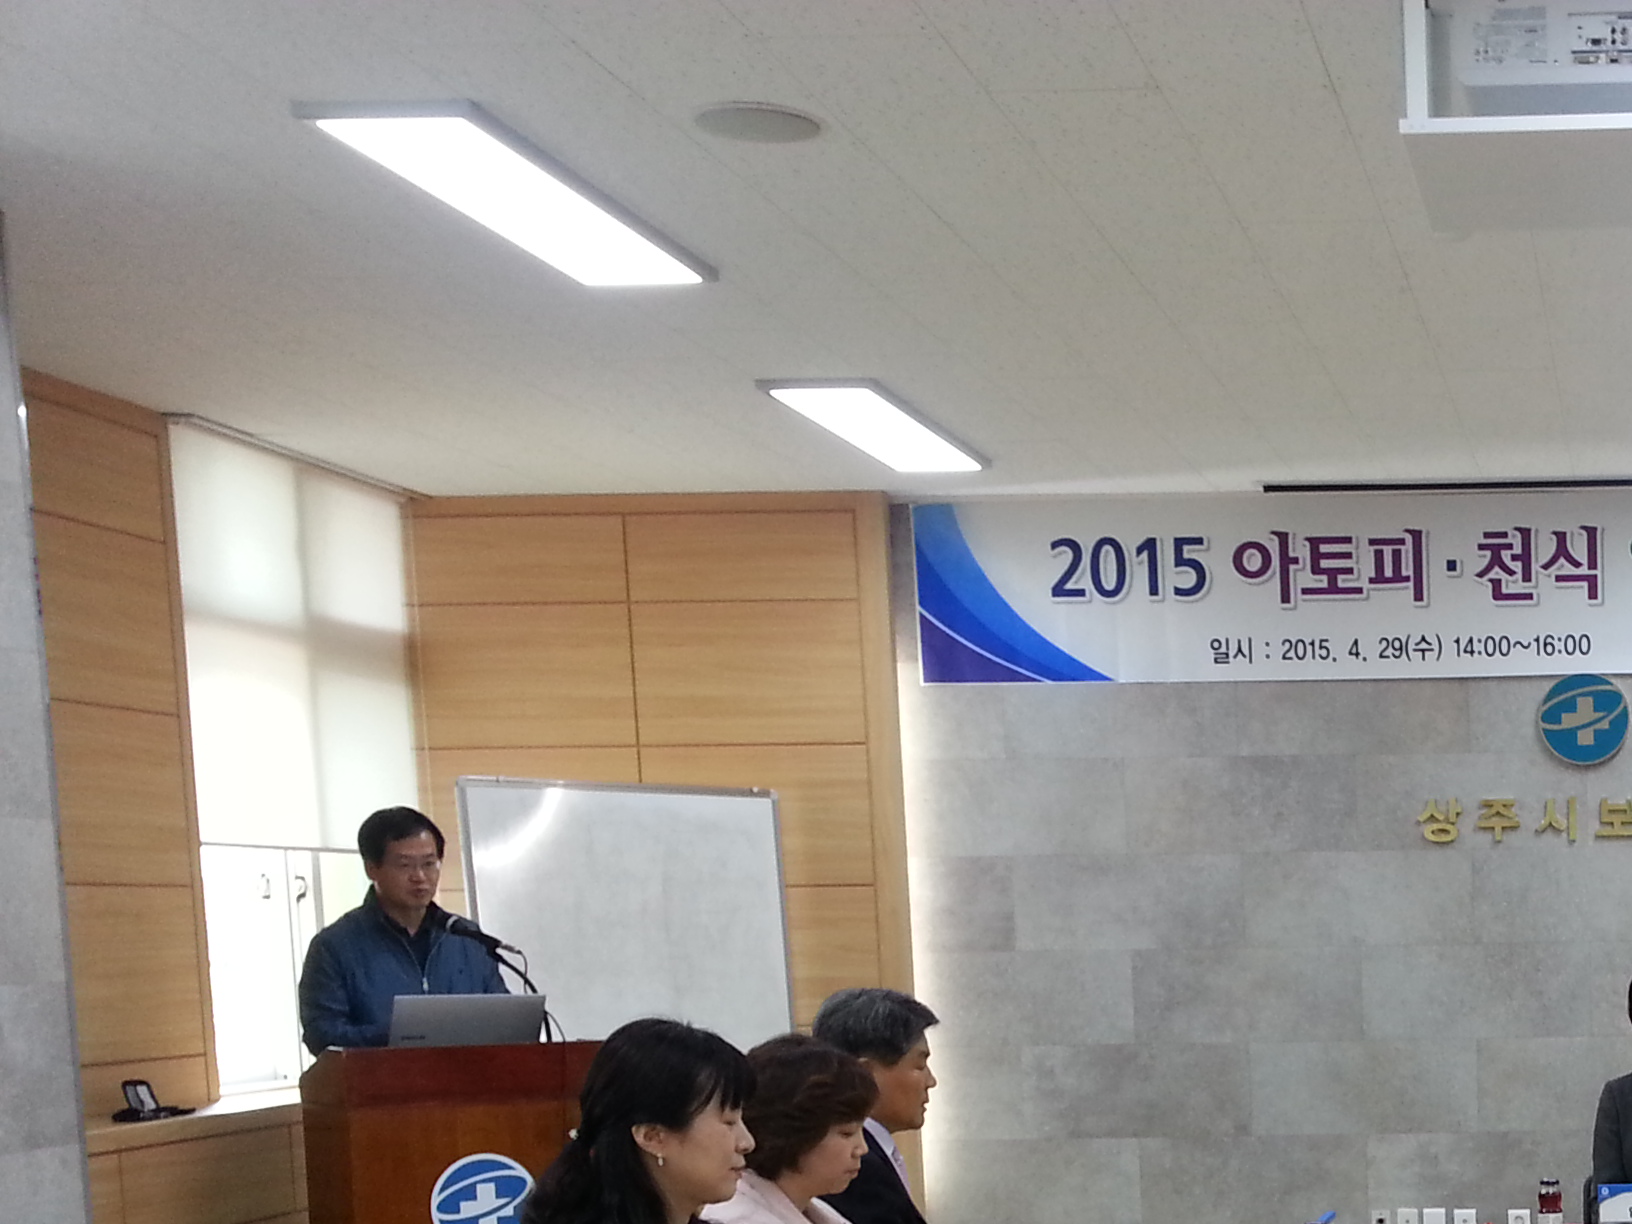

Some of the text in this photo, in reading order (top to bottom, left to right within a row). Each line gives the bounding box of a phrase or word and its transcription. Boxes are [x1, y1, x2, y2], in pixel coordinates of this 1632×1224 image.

[1049, 535, 1208, 600] 2015
[1209, 636, 1253, 665] 일시
[1280, 637, 1338, 663] 2015.
[1347, 637, 1368, 662] 4.
[1378, 632, 1443, 662] 29(수)
[1453, 632, 1592, 660] 14:00~16:00
